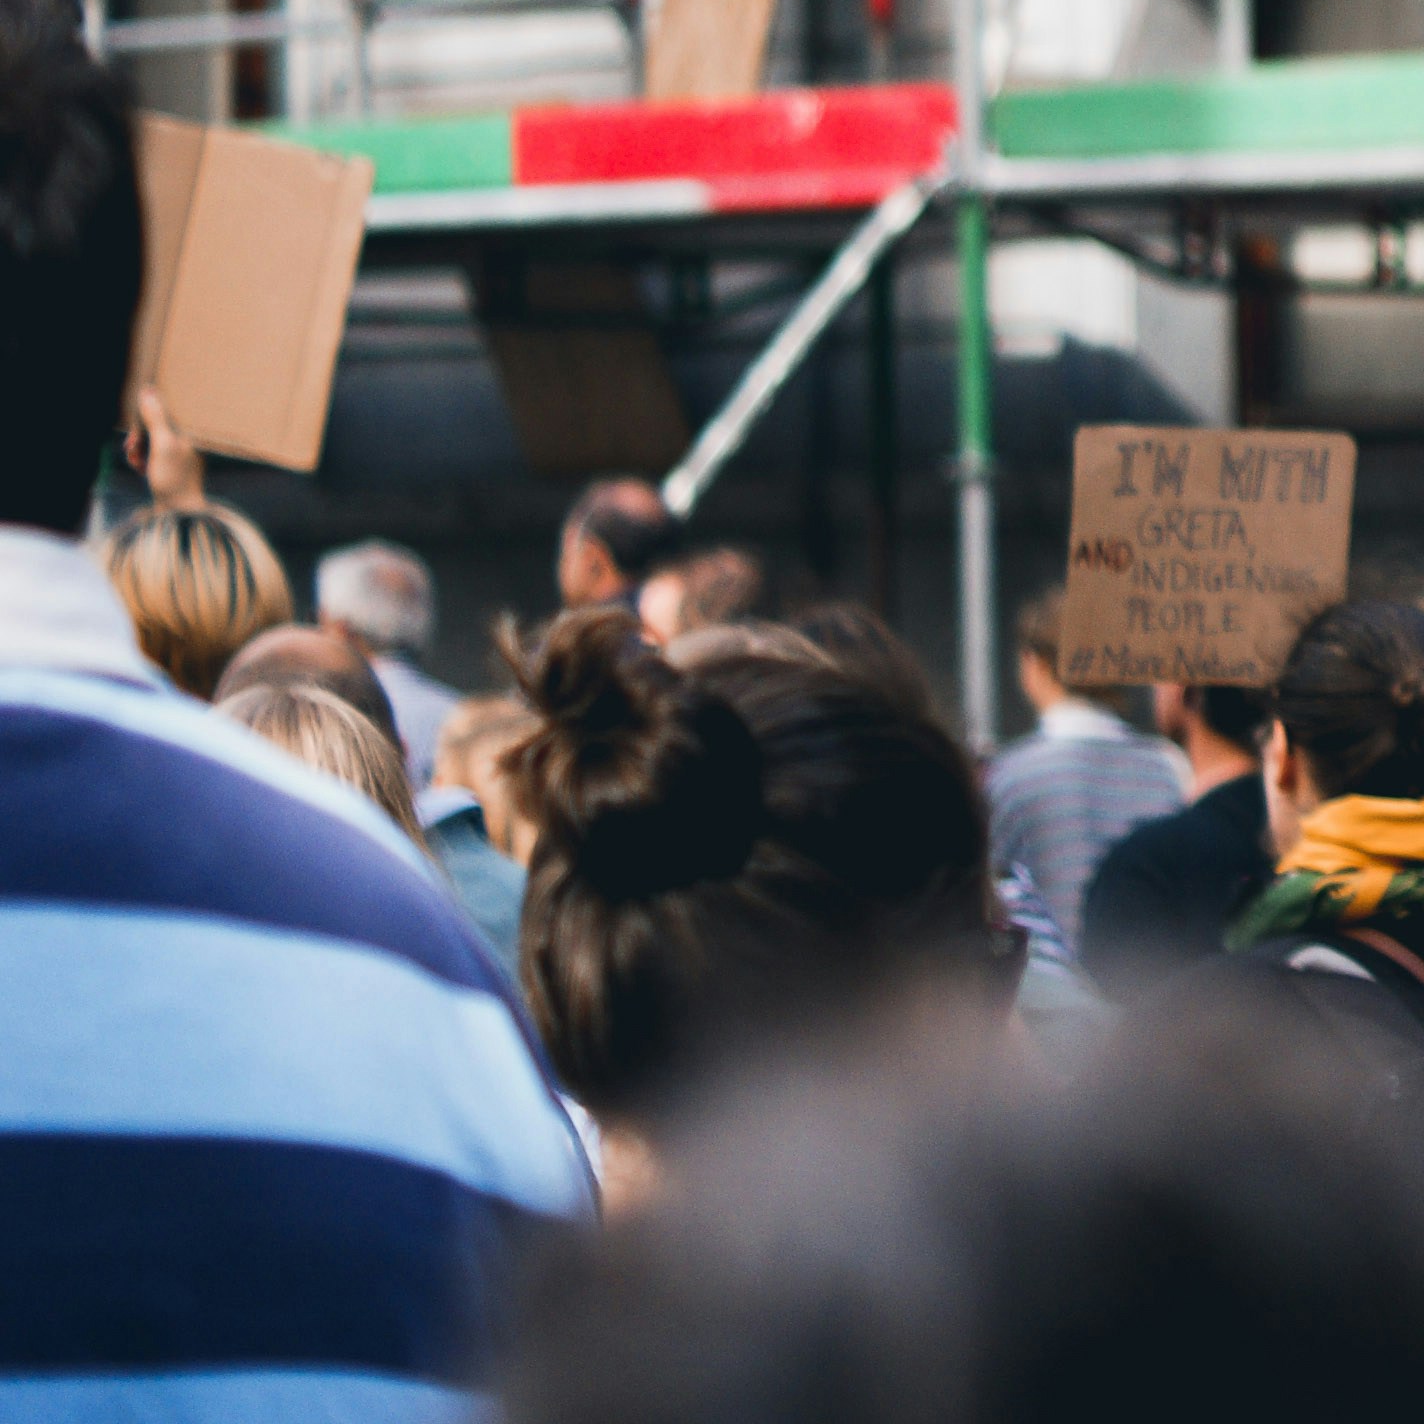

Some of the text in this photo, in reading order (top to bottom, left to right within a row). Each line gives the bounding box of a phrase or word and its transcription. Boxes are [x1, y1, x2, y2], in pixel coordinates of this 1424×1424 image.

[1113, 440, 1331, 504] I'M WITH
[1075, 538, 1134, 573] AND
[1127, 596, 1245, 635] PEOPLE
